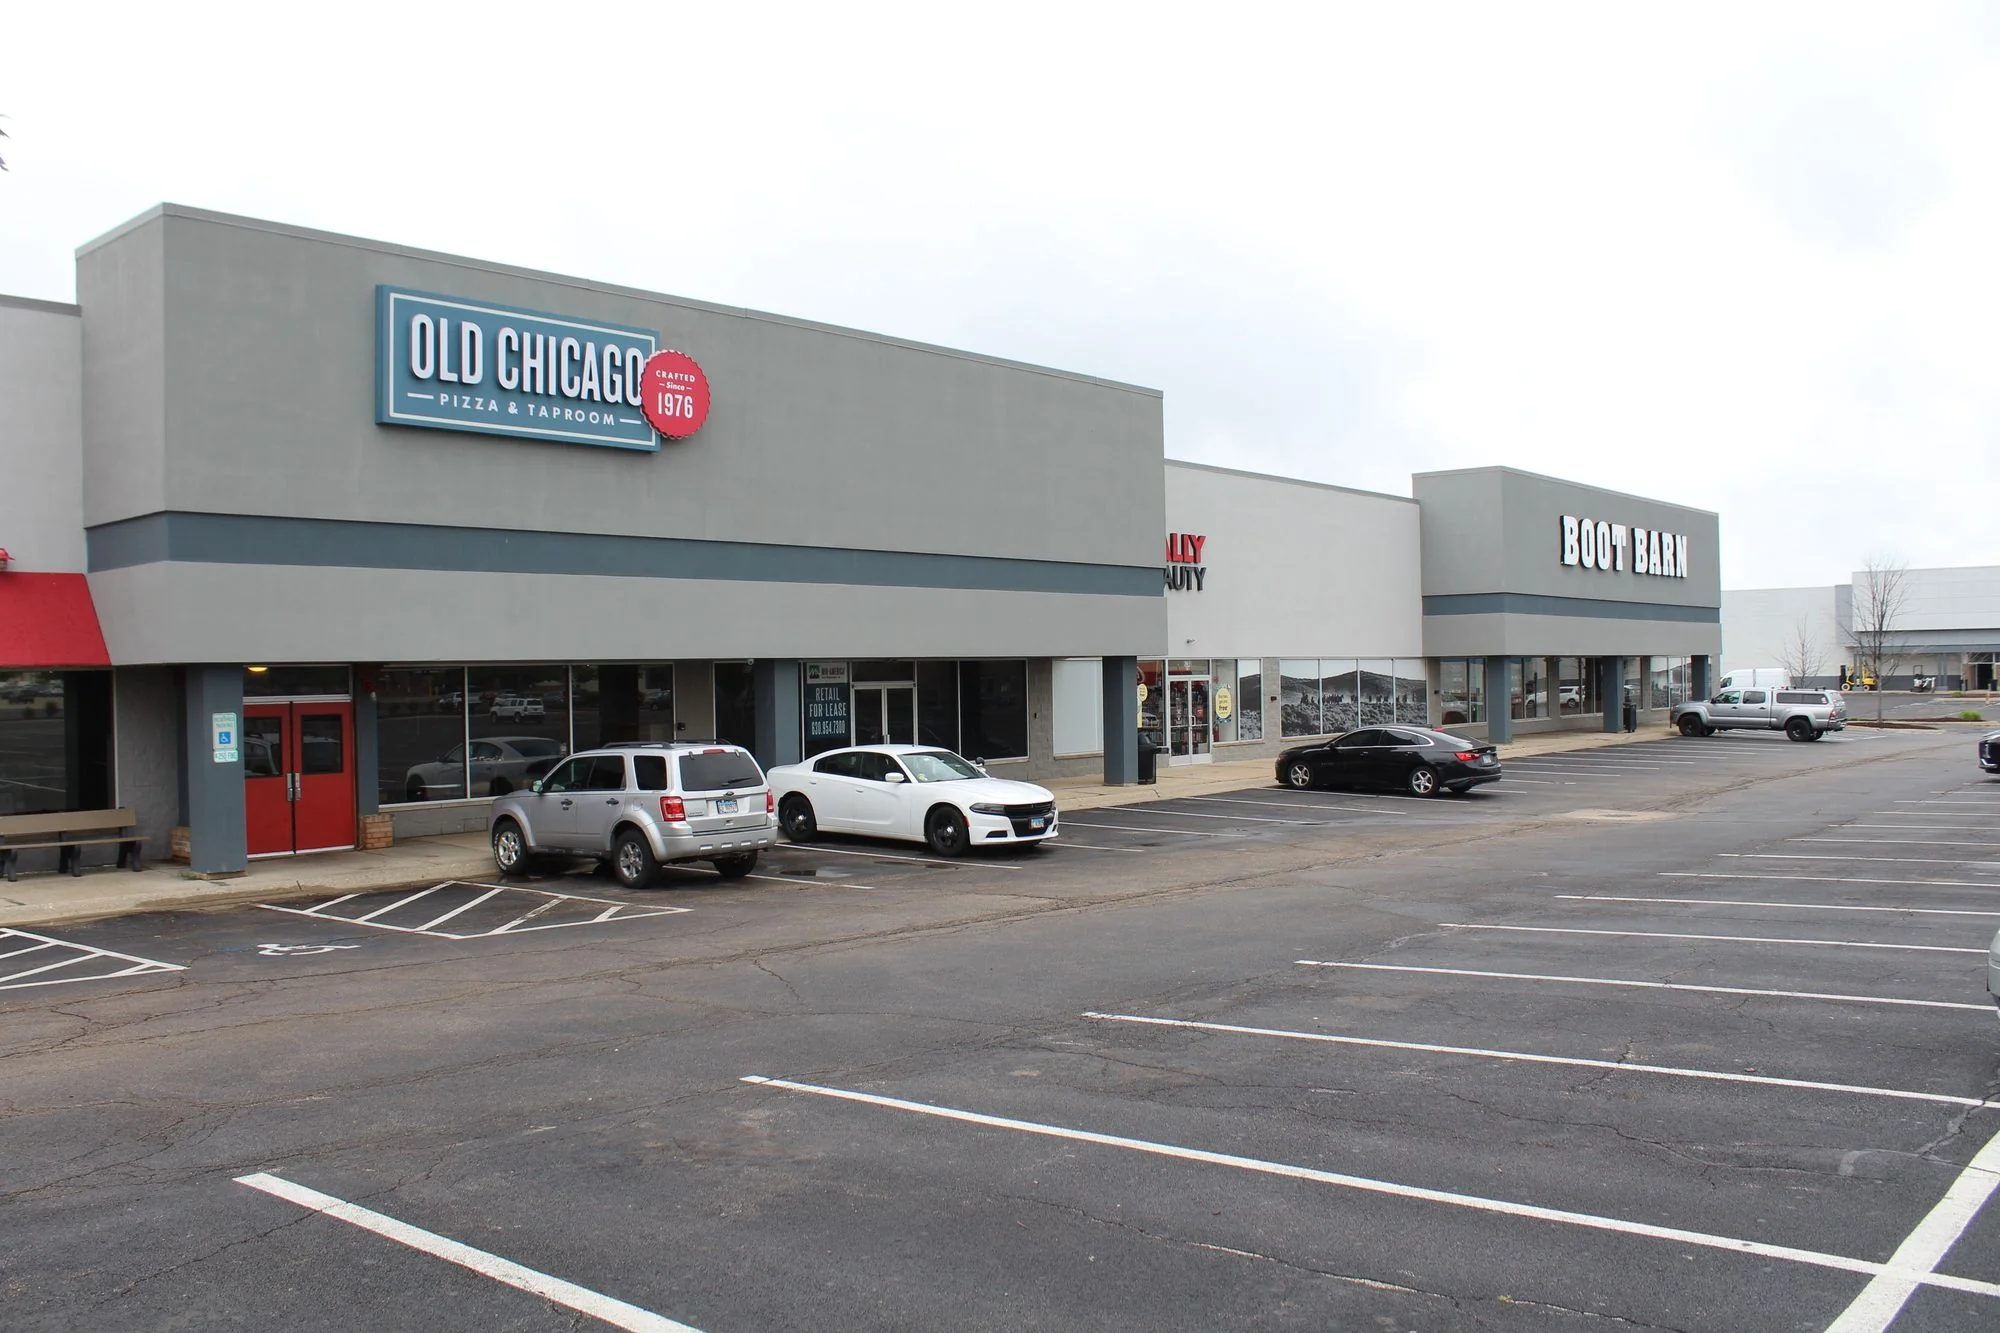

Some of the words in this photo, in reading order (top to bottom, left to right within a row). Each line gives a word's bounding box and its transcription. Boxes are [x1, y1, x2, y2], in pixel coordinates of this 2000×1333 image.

[411, 313, 484, 385] OLD
[497, 327, 644, 407] CHICAGO
[655, 369, 696, 383] CRAFTED
[666, 381, 685, 391] Since
[439, 393, 499, 413] PIZZA
[507, 401, 519, 416] &
[527, 403, 616, 427] TAPROOM
[657, 391, 693, 419] 1976
[1560, 515, 1627, 572] BOOT
[1632, 527, 1688, 578] BARN
[815, 687, 841, 701] RETAIL
[809, 703, 823, 718] FOR
[825, 702, 847, 717] LEASE
